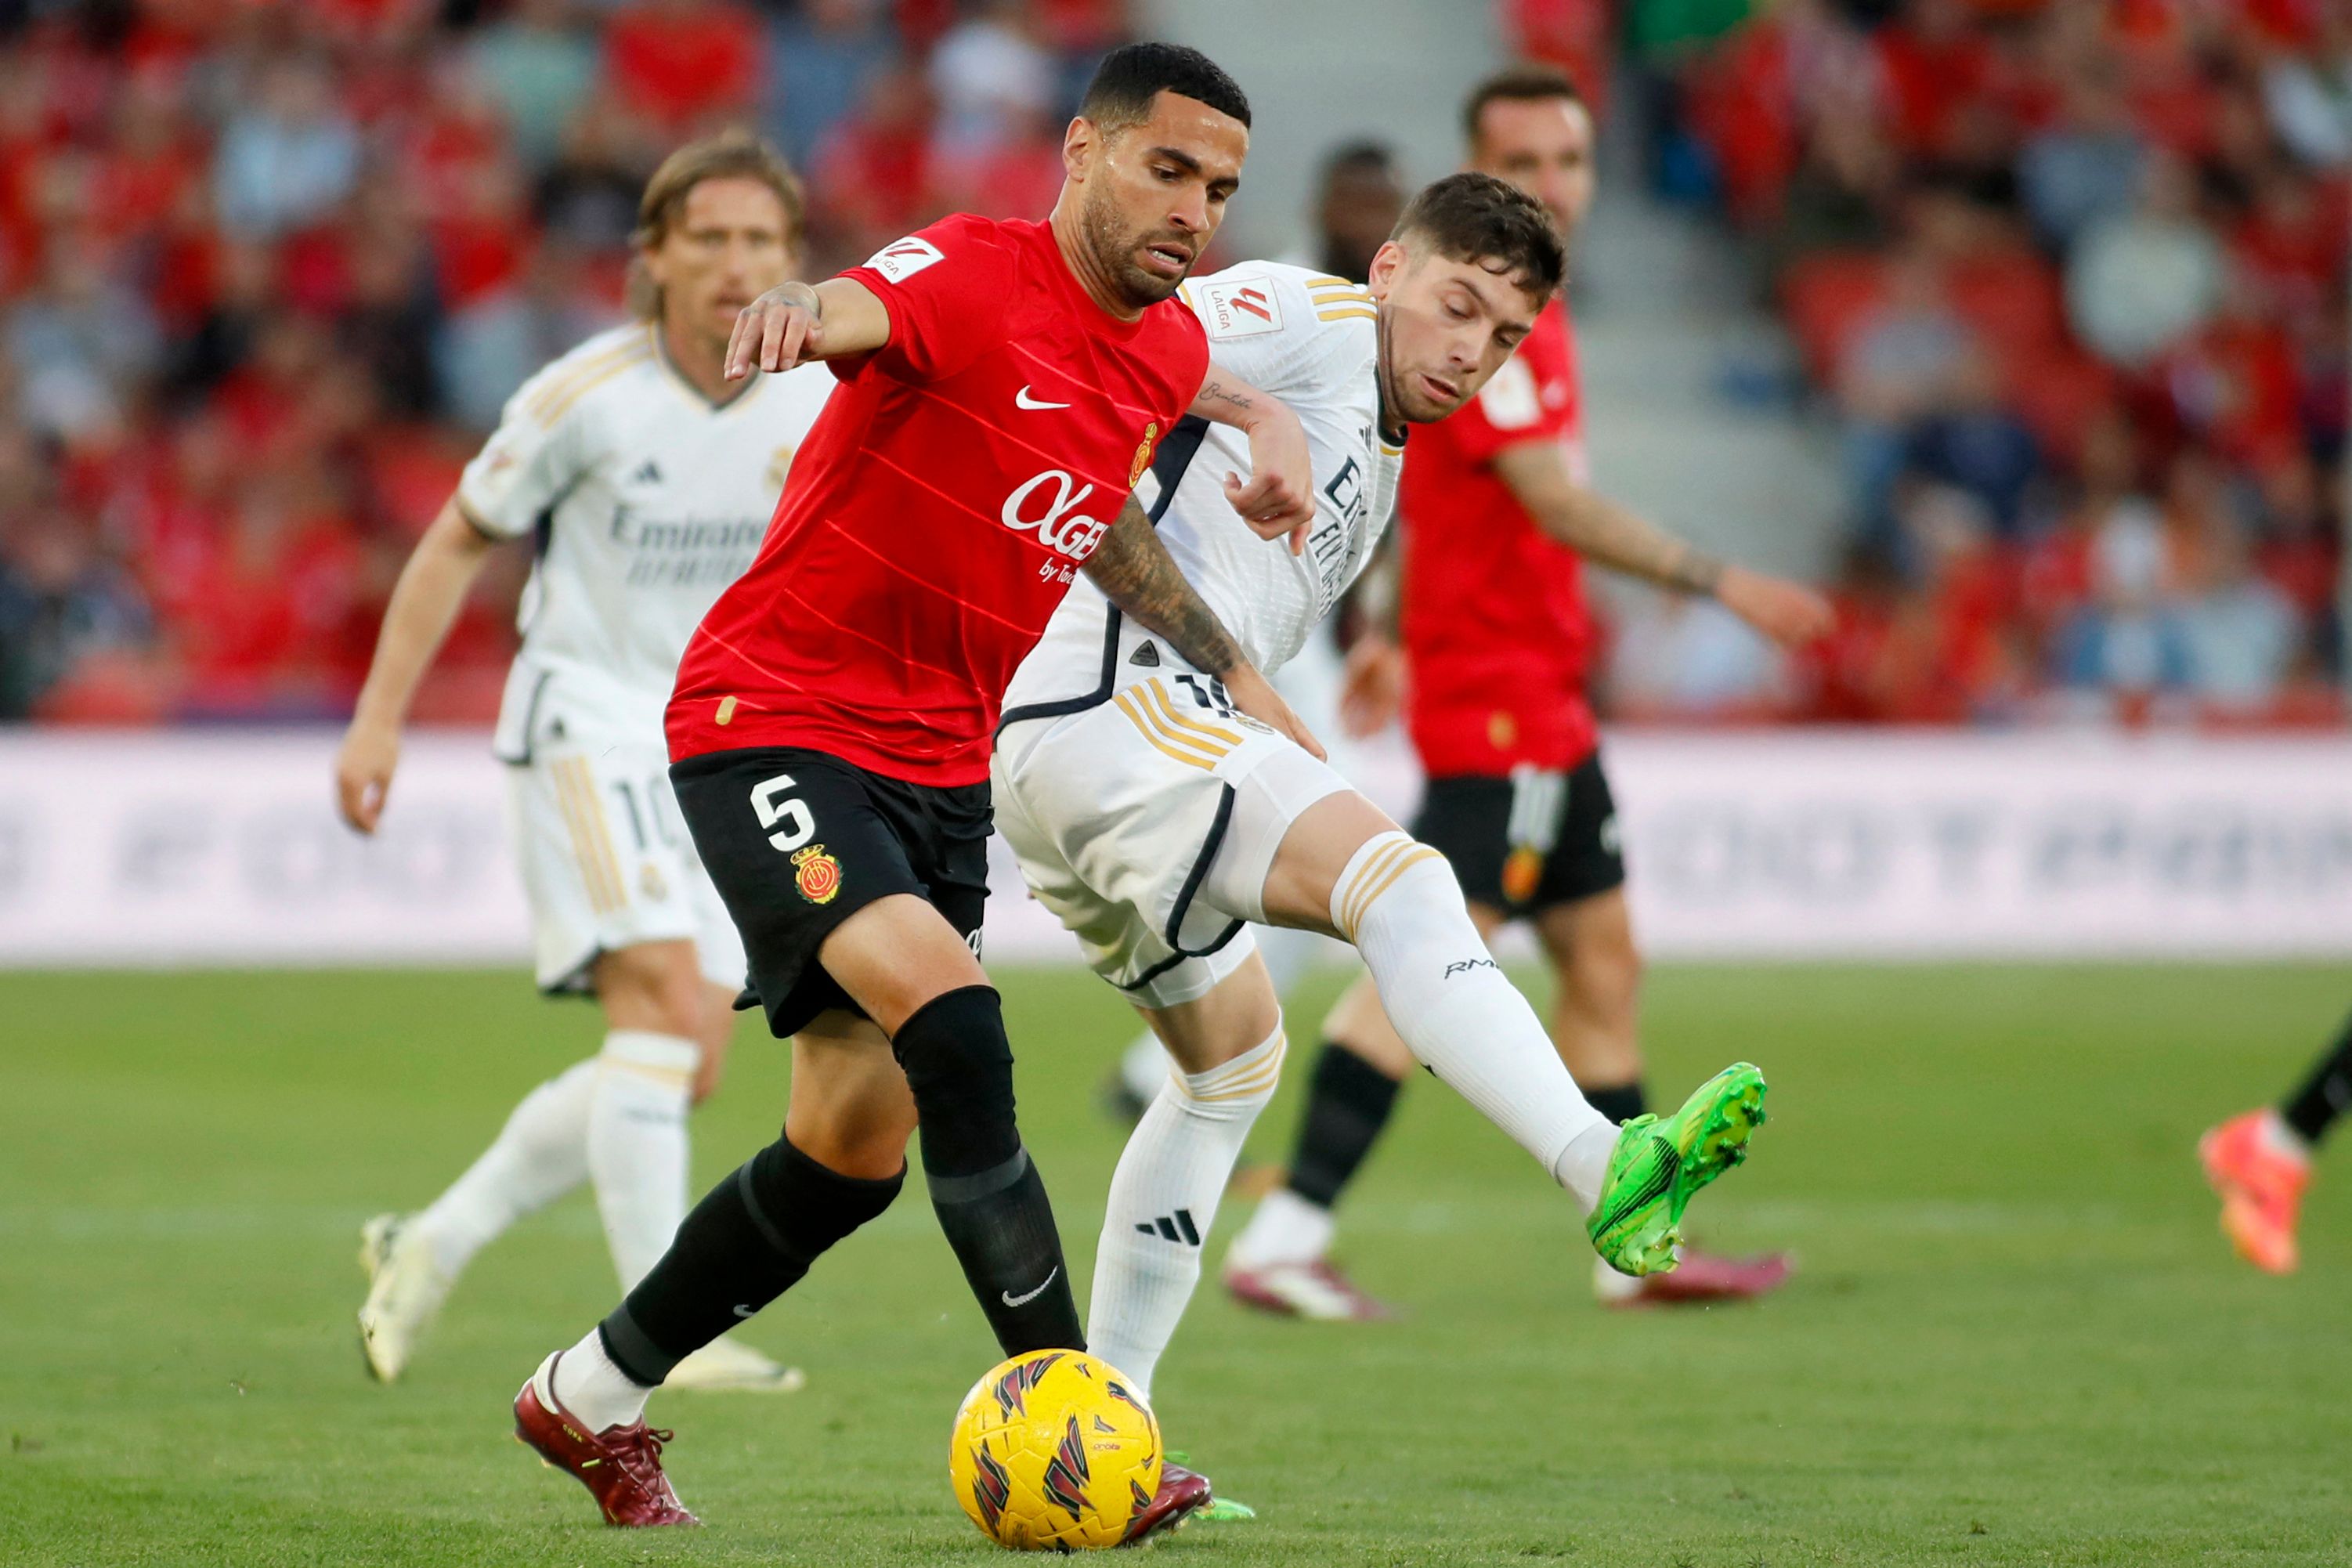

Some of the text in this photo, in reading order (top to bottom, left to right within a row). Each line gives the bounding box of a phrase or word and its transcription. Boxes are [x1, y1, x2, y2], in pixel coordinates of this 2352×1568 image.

[1211, 291, 1230, 330] LALIGA
[1039, 556, 1058, 583] by
[750, 774, 815, 852] 5
